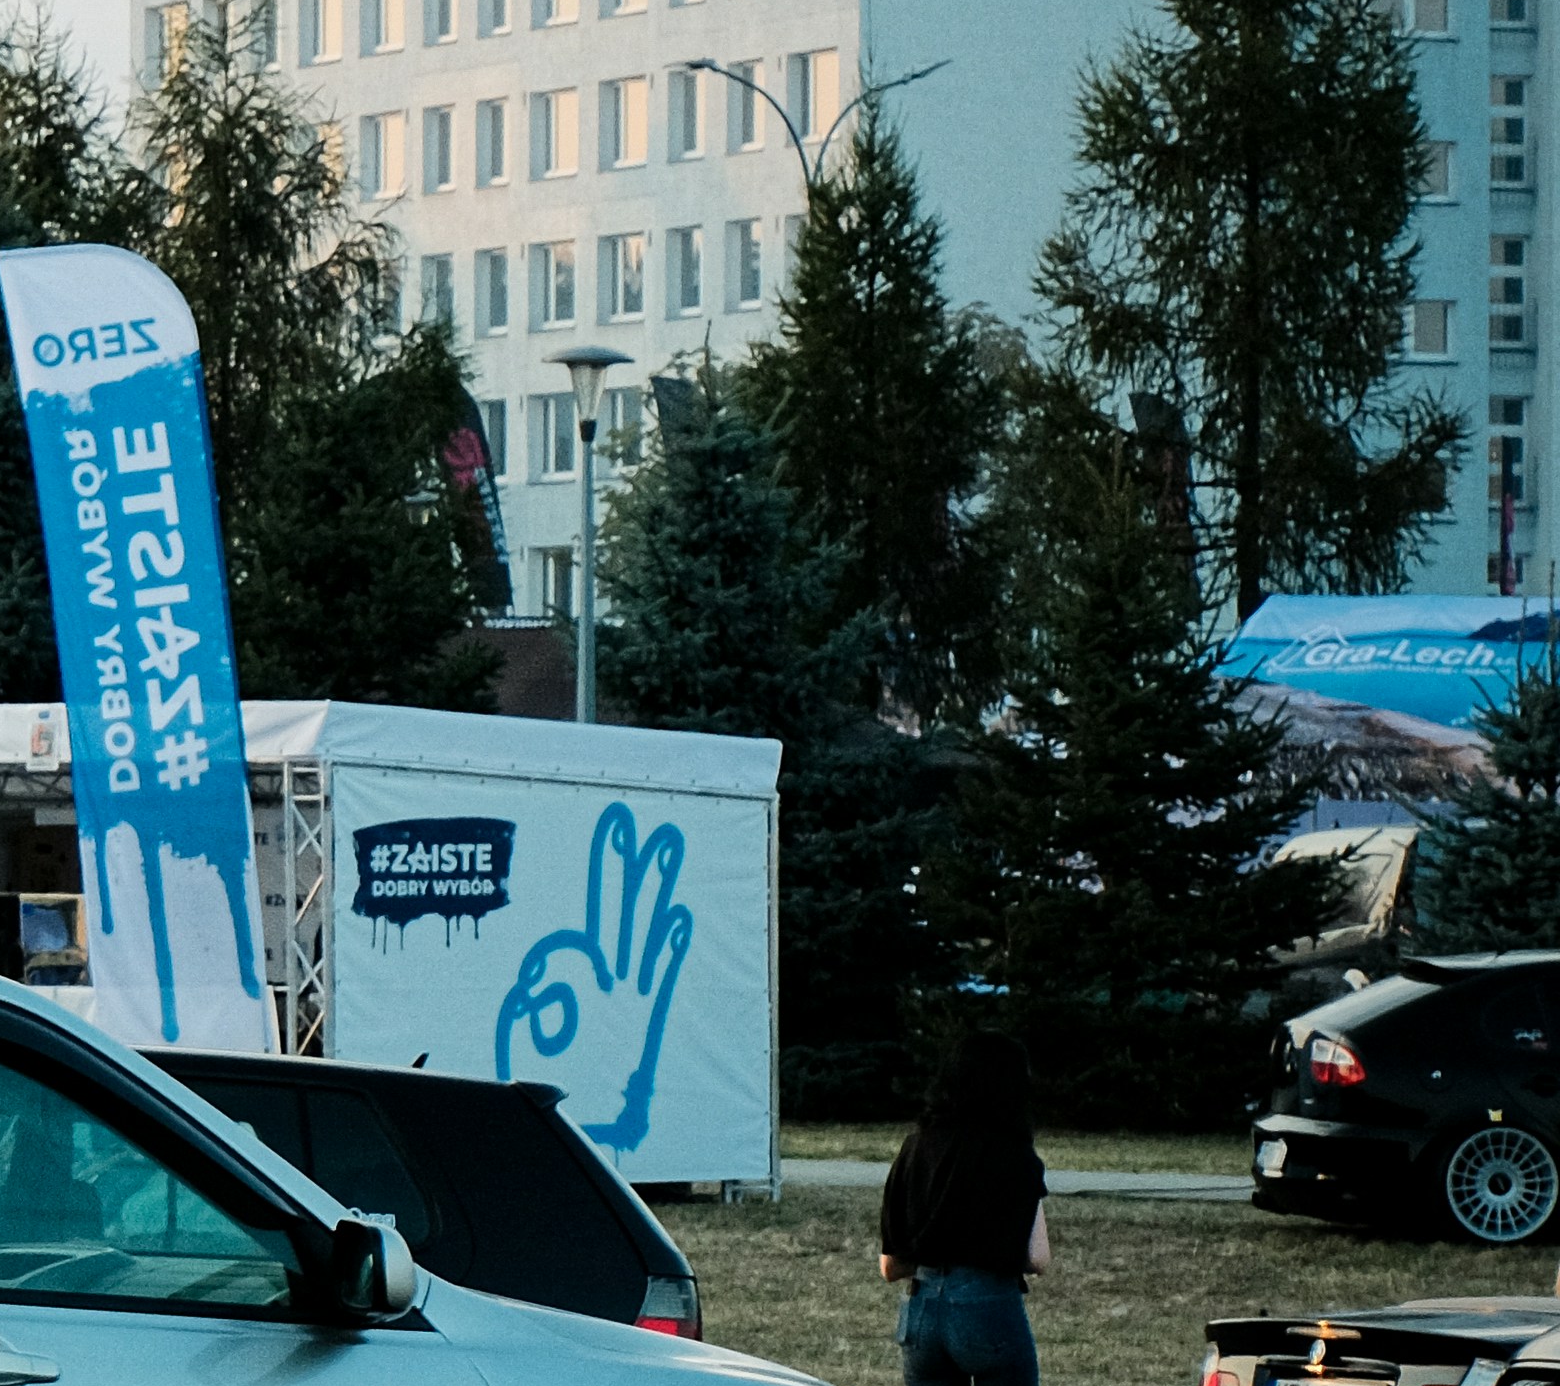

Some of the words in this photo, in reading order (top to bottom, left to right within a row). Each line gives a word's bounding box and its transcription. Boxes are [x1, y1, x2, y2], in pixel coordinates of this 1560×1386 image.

[370, 841, 493, 873] #ZAISTE
[373, 880, 429, 897] DOBRY
[433, 875, 495, 896] WYBÓR
